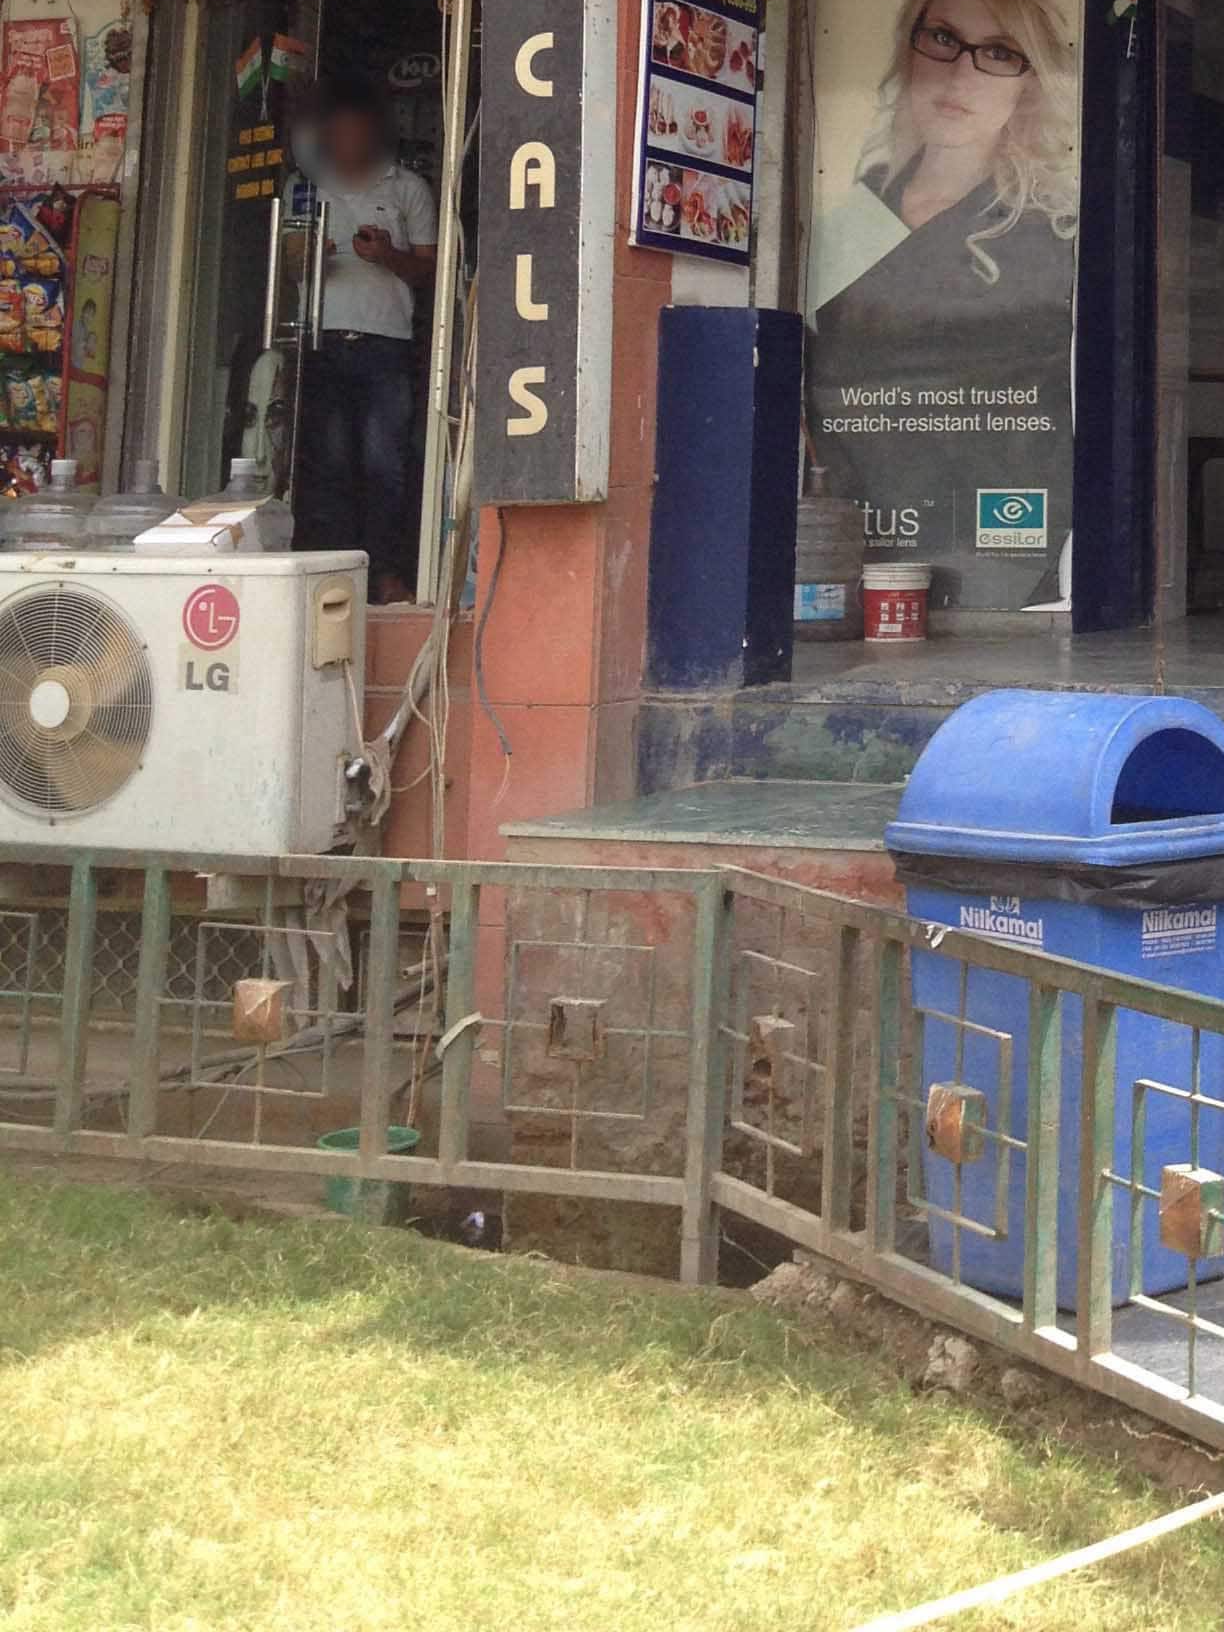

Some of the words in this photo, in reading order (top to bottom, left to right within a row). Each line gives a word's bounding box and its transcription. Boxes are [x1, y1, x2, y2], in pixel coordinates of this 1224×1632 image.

[840, 386, 912, 407] World's
[917, 387, 965, 406] most
[970, 385, 1039, 406] trusted
[822, 413, 981, 433] scratch-resistant
[986, 413, 1057, 432] lenses.
[185, 661, 230, 693] LG
[960, 905, 1044, 940] Nilkamal
[1142, 904, 1217, 933] Nilkamal
